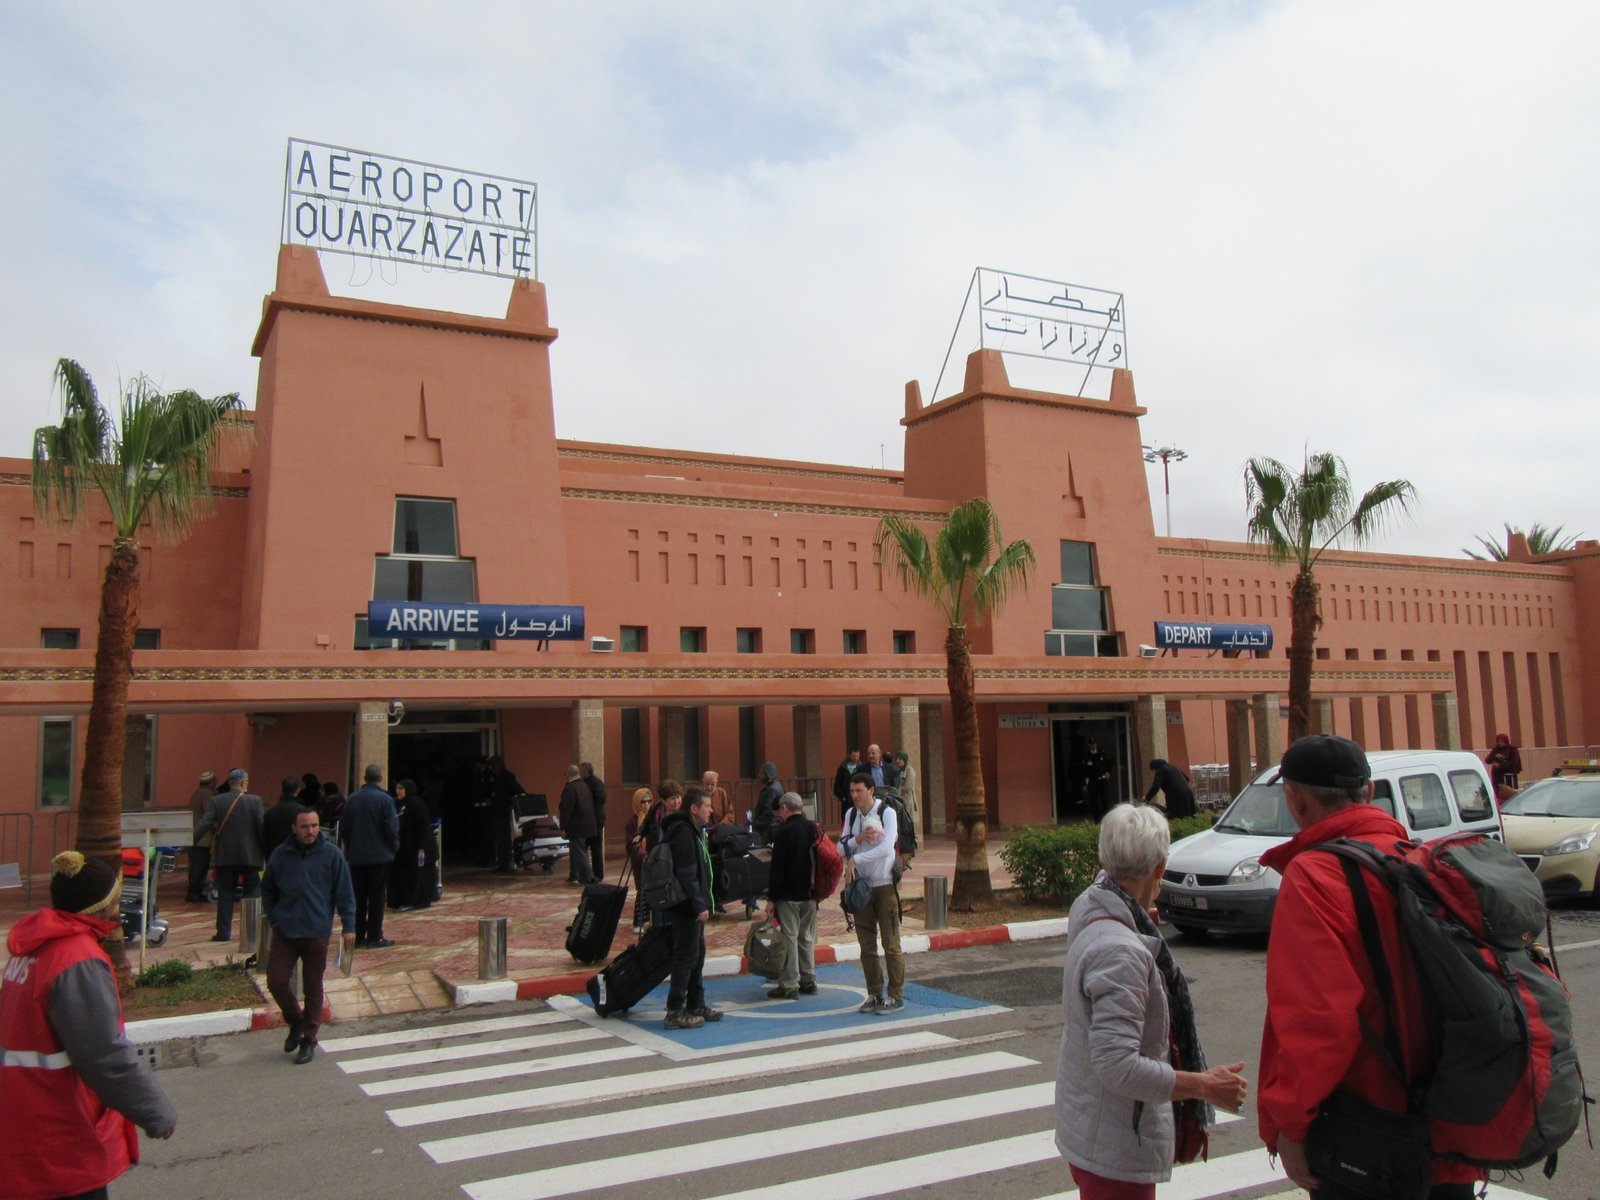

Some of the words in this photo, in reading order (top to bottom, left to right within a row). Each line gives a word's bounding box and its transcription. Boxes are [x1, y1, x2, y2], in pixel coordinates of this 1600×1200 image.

[297, 150, 531, 223] AEROPORT
[296, 202, 531, 272] OUARZAZATE
[984, 276, 1120, 322] مطار
[386, 608, 479, 633] ARRIVEE
[495, 611, 571, 637] الوصول
[1164, 625, 1212, 645] DEPART
[1222, 629, 1268, 648] الذهاب
[3, 956, 30, 985] AVIS
